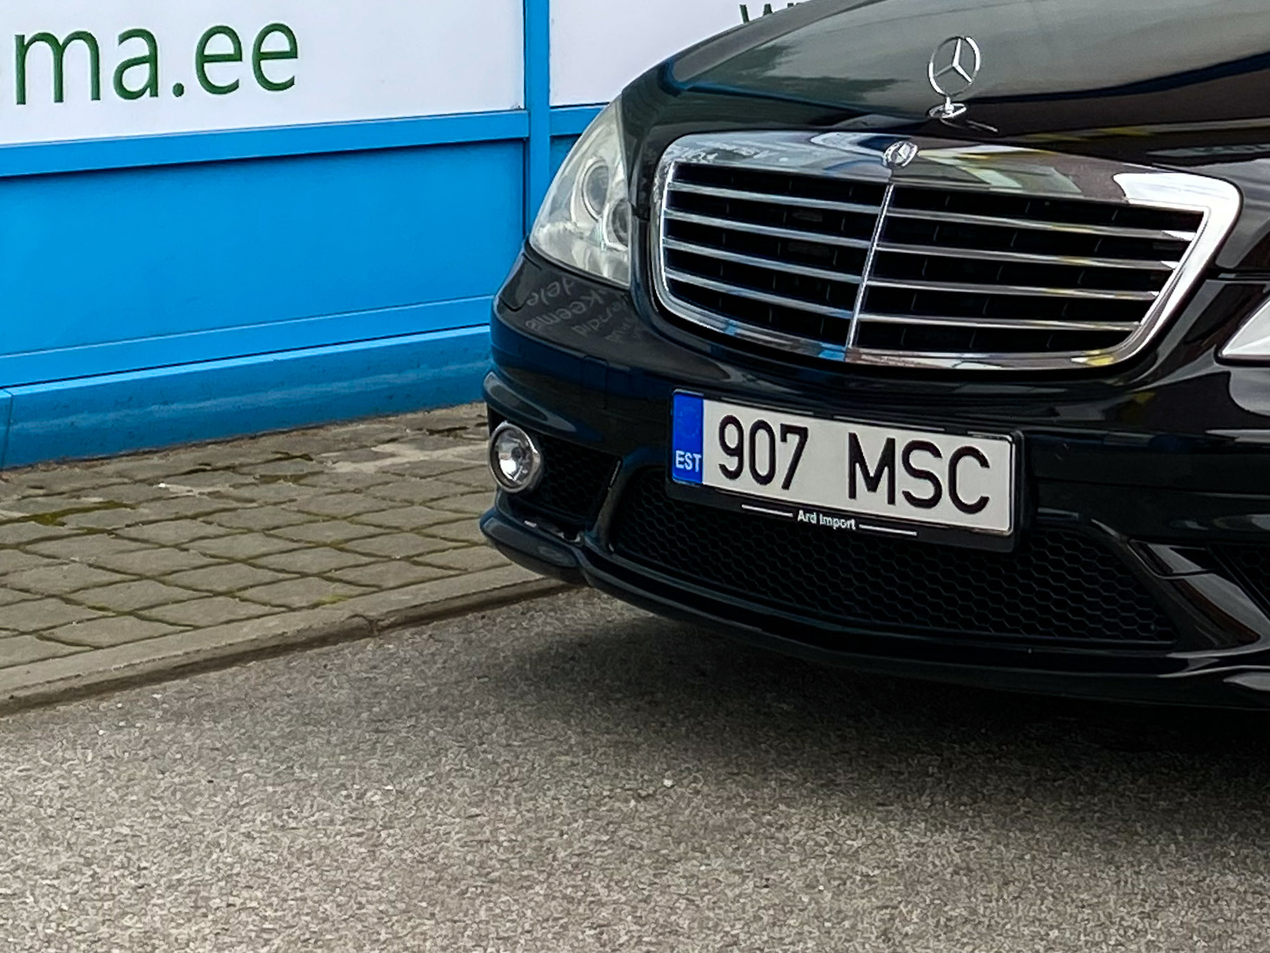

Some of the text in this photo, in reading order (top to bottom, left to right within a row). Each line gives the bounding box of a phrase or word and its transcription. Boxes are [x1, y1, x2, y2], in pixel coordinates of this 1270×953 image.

[14, 21, 299, 106] ma.ee
[675, 414, 990, 515] EST 907 MSC
[797, 509, 856, 530] Ard Import
